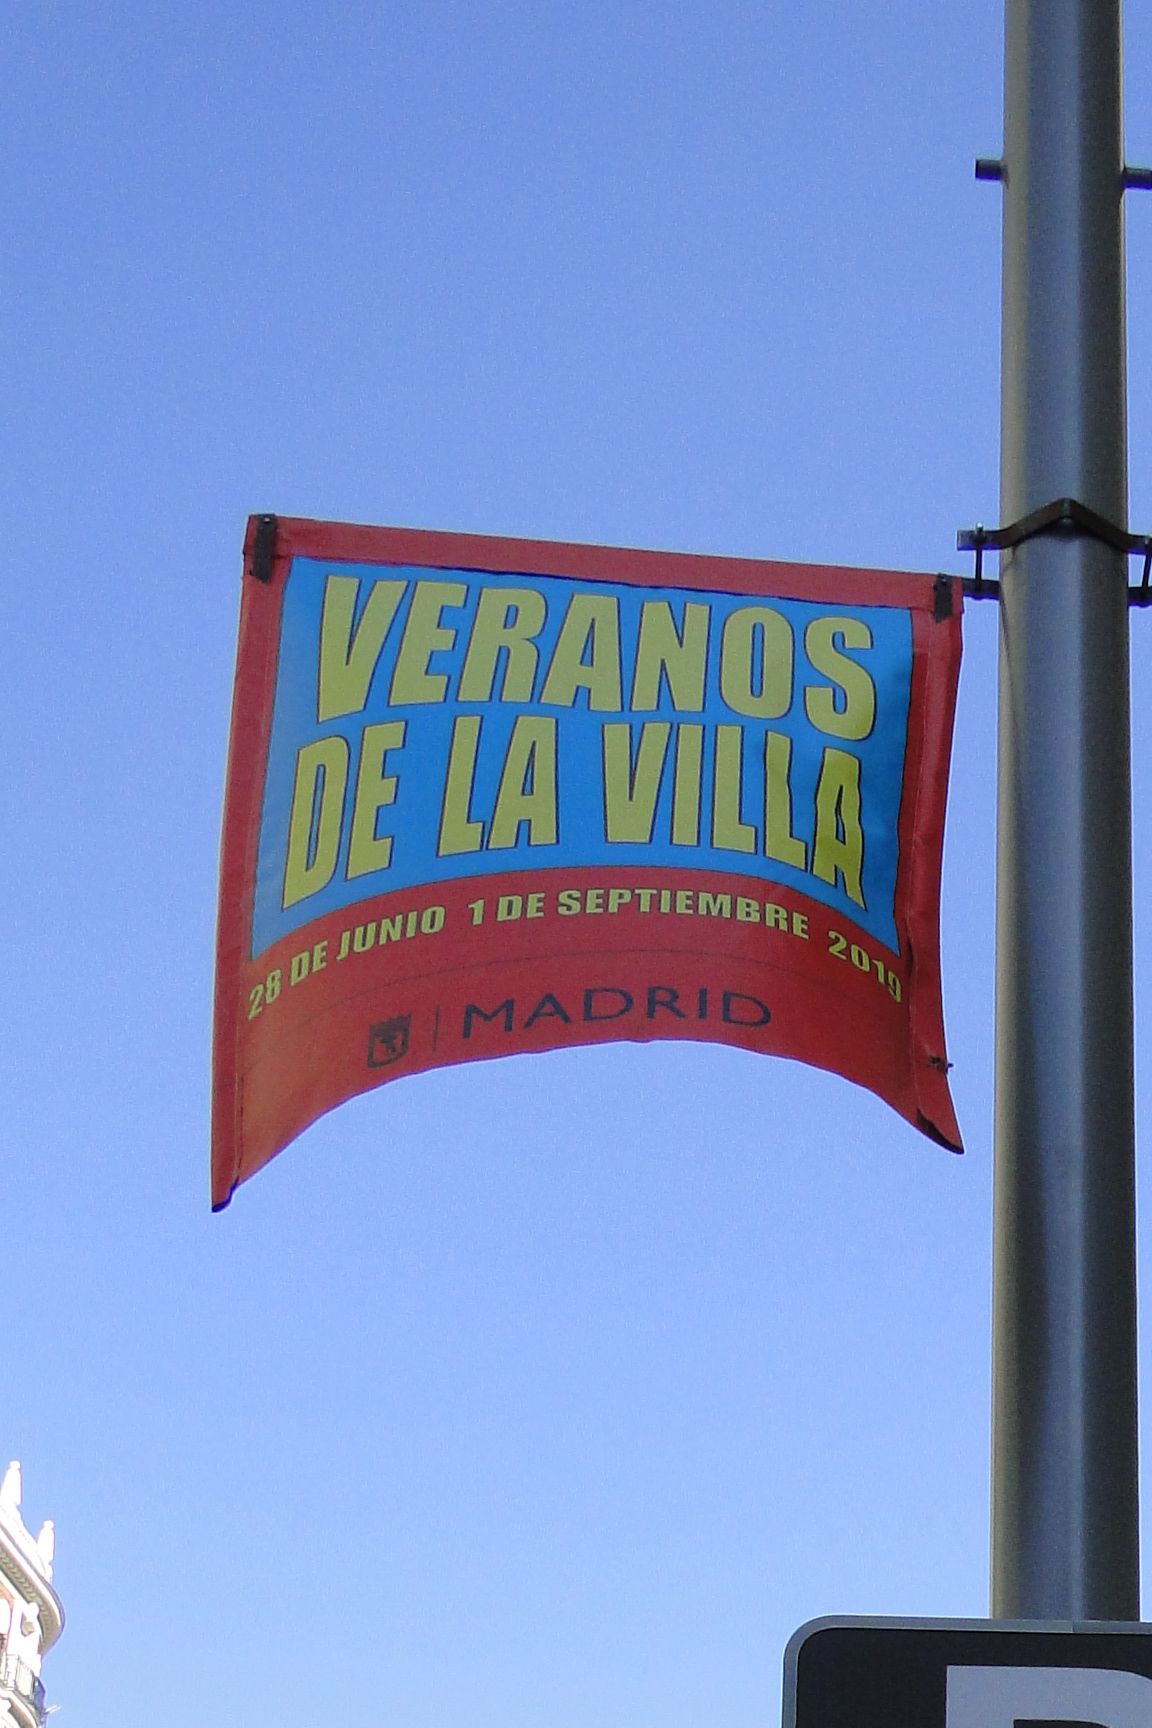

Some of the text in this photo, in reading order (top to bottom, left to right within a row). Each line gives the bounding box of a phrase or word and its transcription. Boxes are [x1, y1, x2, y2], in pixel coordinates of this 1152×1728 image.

[317, 575, 877, 741] VERANOS
[281, 714, 868, 911] DE LA VILLA
[248, 888, 903, 1020] 28 DE JUNIO 1 DE SEPTIEMBRE 2019
[462, 986, 772, 1039] MADRID
